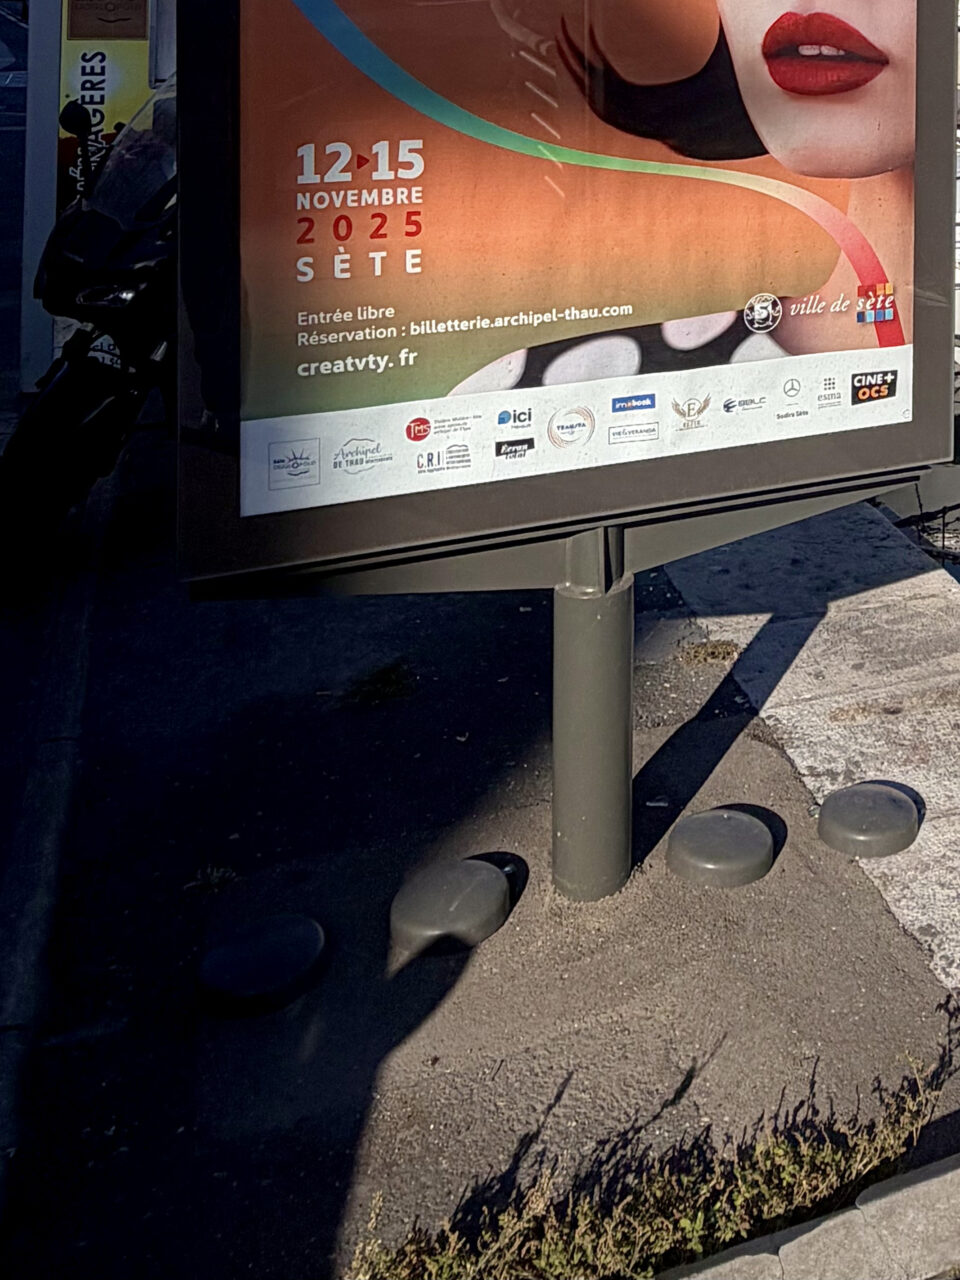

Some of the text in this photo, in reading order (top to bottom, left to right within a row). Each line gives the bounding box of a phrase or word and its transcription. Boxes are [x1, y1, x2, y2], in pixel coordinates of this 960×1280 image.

[296, 185, 423, 210] NOVEMBRE
[296, 210, 423, 245] 2025
[296, 246, 423, 282] SÈTE
[790, 291, 894, 316] ville de sète
[297, 305, 395, 326] Entrée libre
[297, 324, 397, 346] Réservation
[410, 303, 633, 336] billetterie.archipel-thau.com
[853, 372, 895, 387] CINE+
[857, 385, 889, 400] OCS
[512, 408, 532, 423] ici
[407, 421, 431, 439] TMS
[333, 442, 382, 461] Archipel
